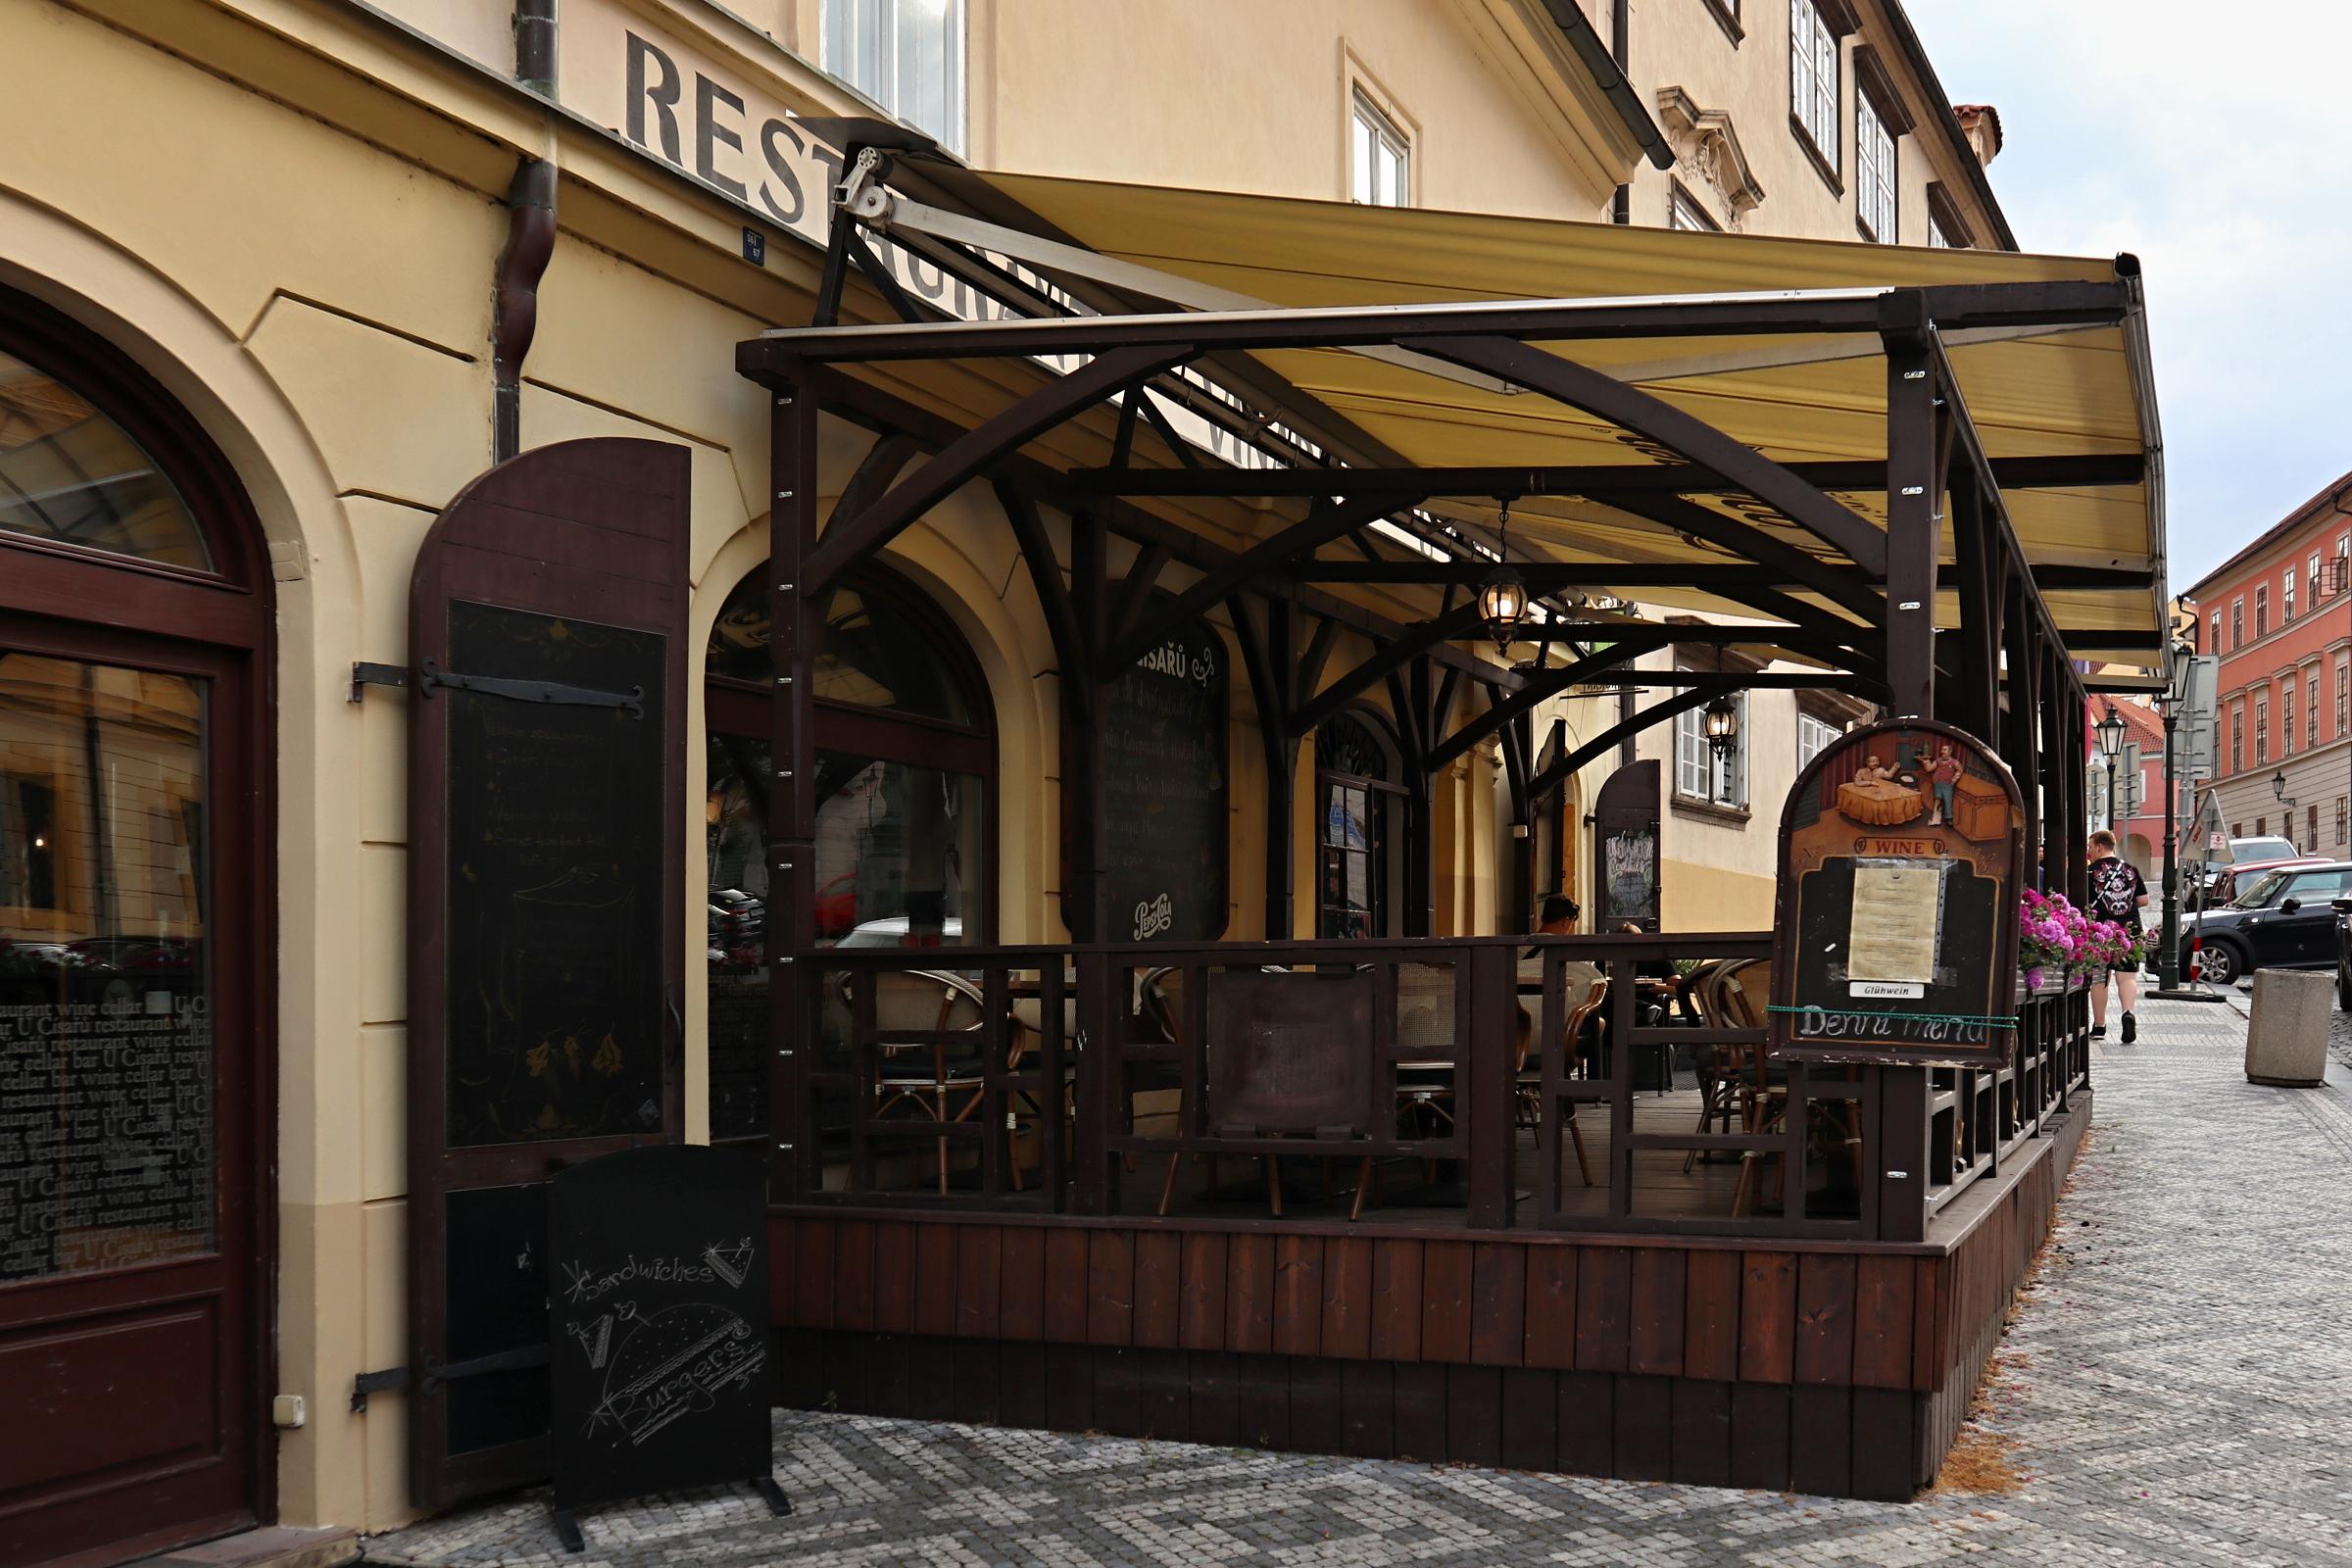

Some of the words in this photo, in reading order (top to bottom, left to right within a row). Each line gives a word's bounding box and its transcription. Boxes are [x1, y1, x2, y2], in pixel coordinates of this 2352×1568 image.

[1876, 840, 1925, 855] WINE
[1864, 986, 1910, 996] Glühwein
[56, 1000, 96, 1016] wine
[100, 996, 142, 1015] cellar
[174, 996, 188, 1013] U
[18, 1017, 32, 1035] U
[94, 1018, 172, 1033] restaurant
[51, 1038, 129, 1052] restaurant
[133, 1032, 171, 1048] wine
[24, 1053, 68, 1070] cellar
[73, 1052, 99, 1068] bar
[103, 1050, 116, 1067] U
[1, 1071, 46, 1090] cellar
[51, 1070, 77, 1087] bar
[80, 1068, 120, 1086] wine
[124, 1064, 165, 1083] cellar
[170, 1063, 192, 1080] bar
[197, 1062, 209, 1079] U
[1, 1092, 84, 1109] restaurant
[87, 1086, 127, 1102] wine
[131, 1081, 171, 1099] cellar
[175, 1079, 199, 1097] bar
[58, 1104, 97, 1121] wine
[102, 1100, 143, 1118] cellar
[148, 1098, 172, 1115] bar
[176, 1097, 189, 1114] U
[24, 1123, 68, 1143] cellar
[74, 1122, 99, 1139] bar
[104, 1119, 117, 1137] U
[29, 1143, 109, 1160] restaurant
[58, 1158, 98, 1175] wine
[176, 1146, 189, 1164] U
[20, 1178, 33, 1198] U
[22, 1195, 102, 1216] restaurant
[107, 1188, 144, 1205] wine
[148, 1182, 188, 1200] cellar
[20, 1216, 33, 1234] U
[98, 1204, 172, 1225] restaurant
[3, 1251, 48, 1273] cellar
[580, 1254, 714, 1300] Sandwiches
[605, 1341, 746, 1431] Burgers
